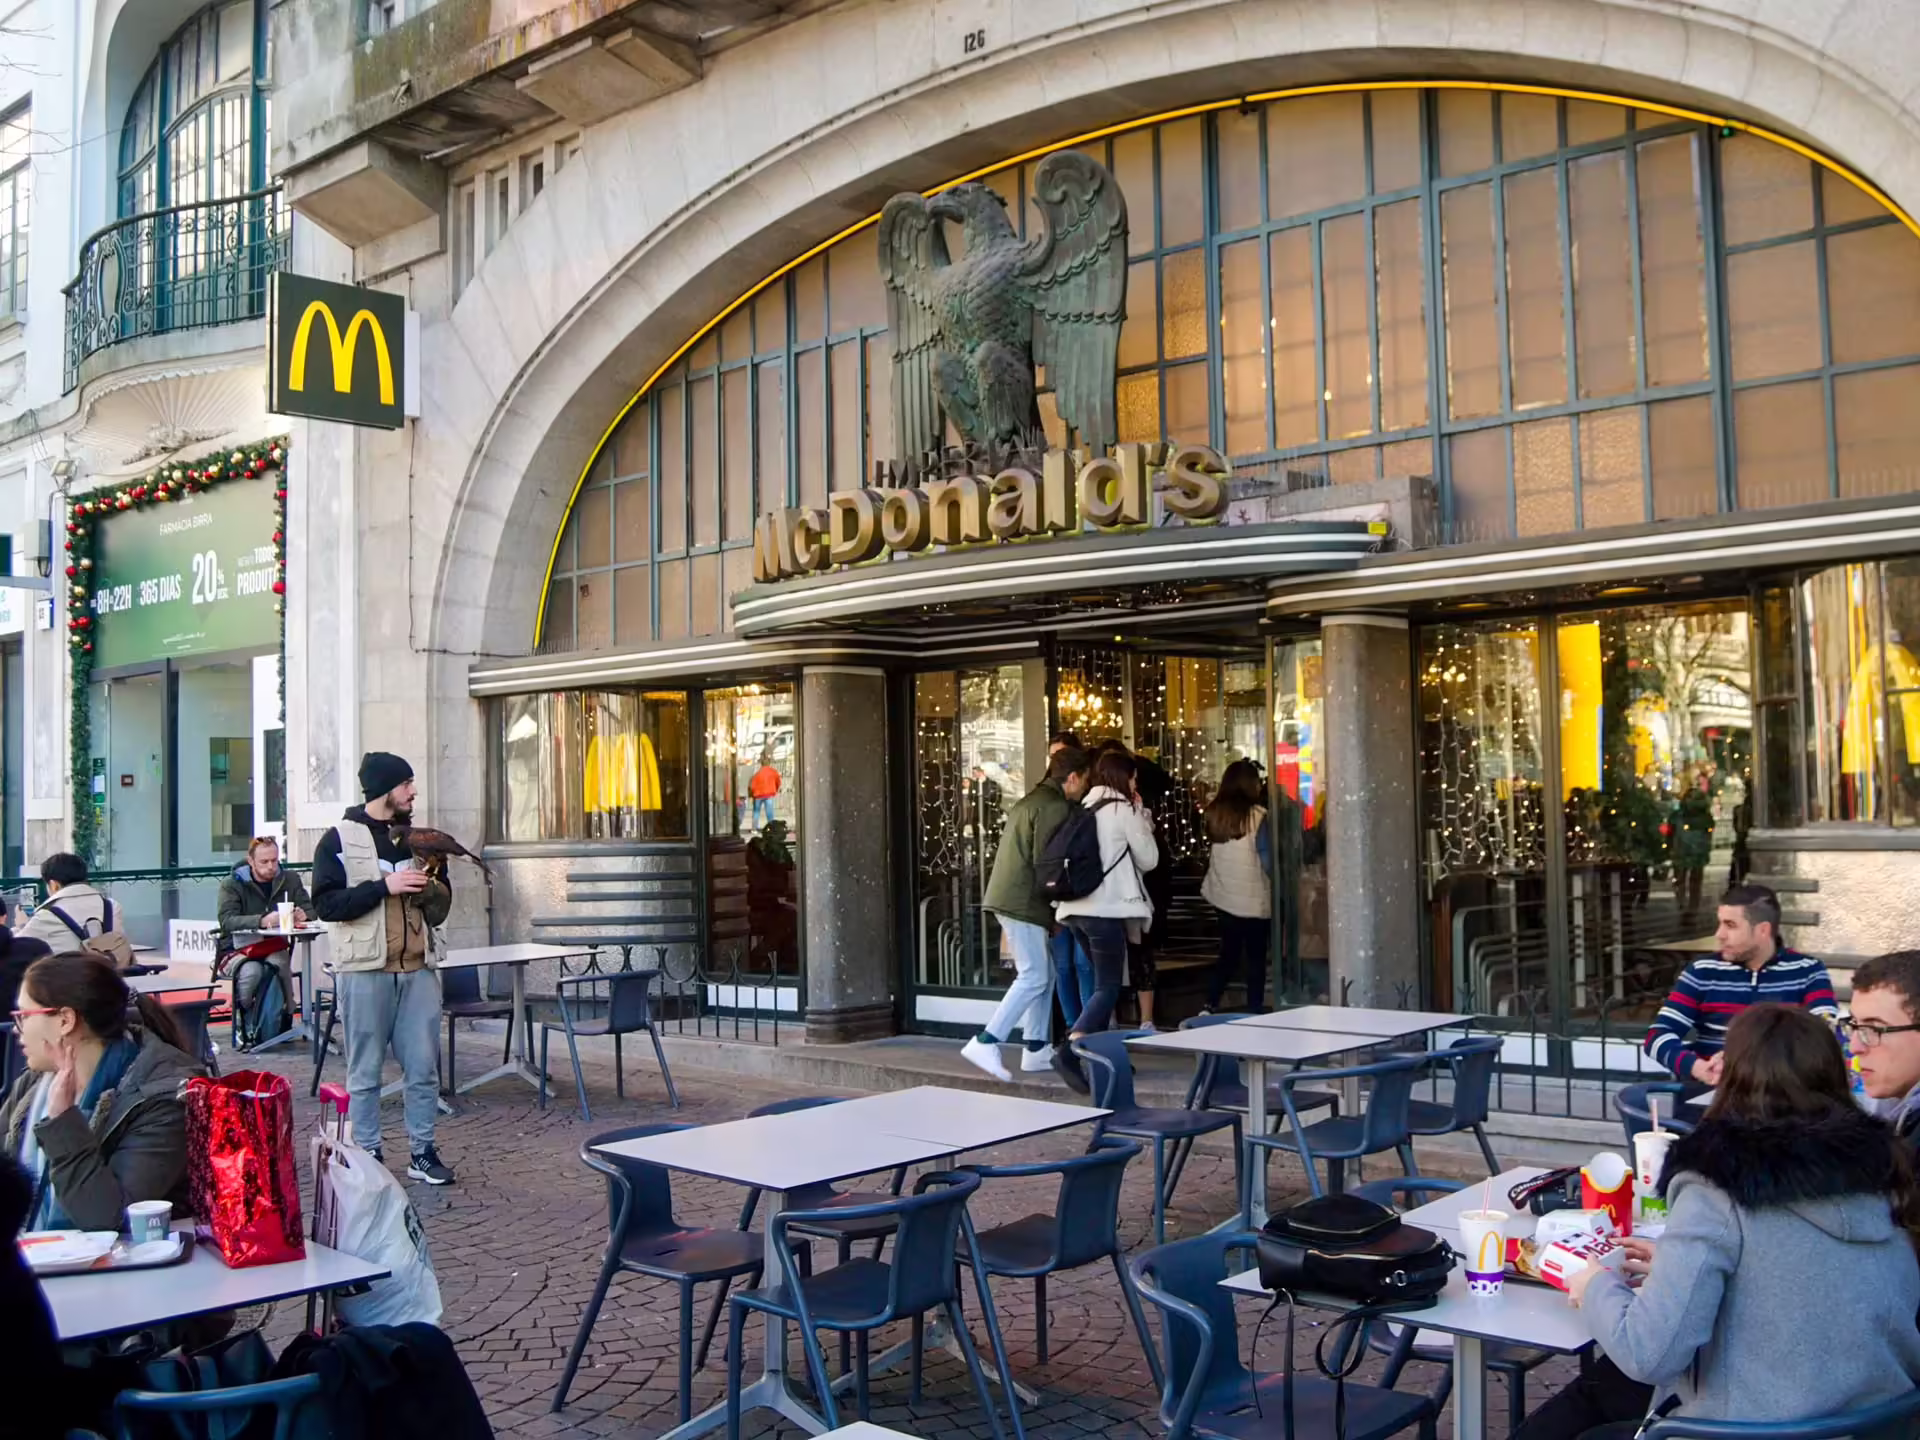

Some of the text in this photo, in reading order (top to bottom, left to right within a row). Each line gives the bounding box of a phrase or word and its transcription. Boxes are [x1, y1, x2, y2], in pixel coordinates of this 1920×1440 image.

[964, 29, 985, 54] 126
[754, 442, 1229, 584] McDonald's
[140, 577, 159, 606] 365
[160, 573, 182, 602] DIAS
